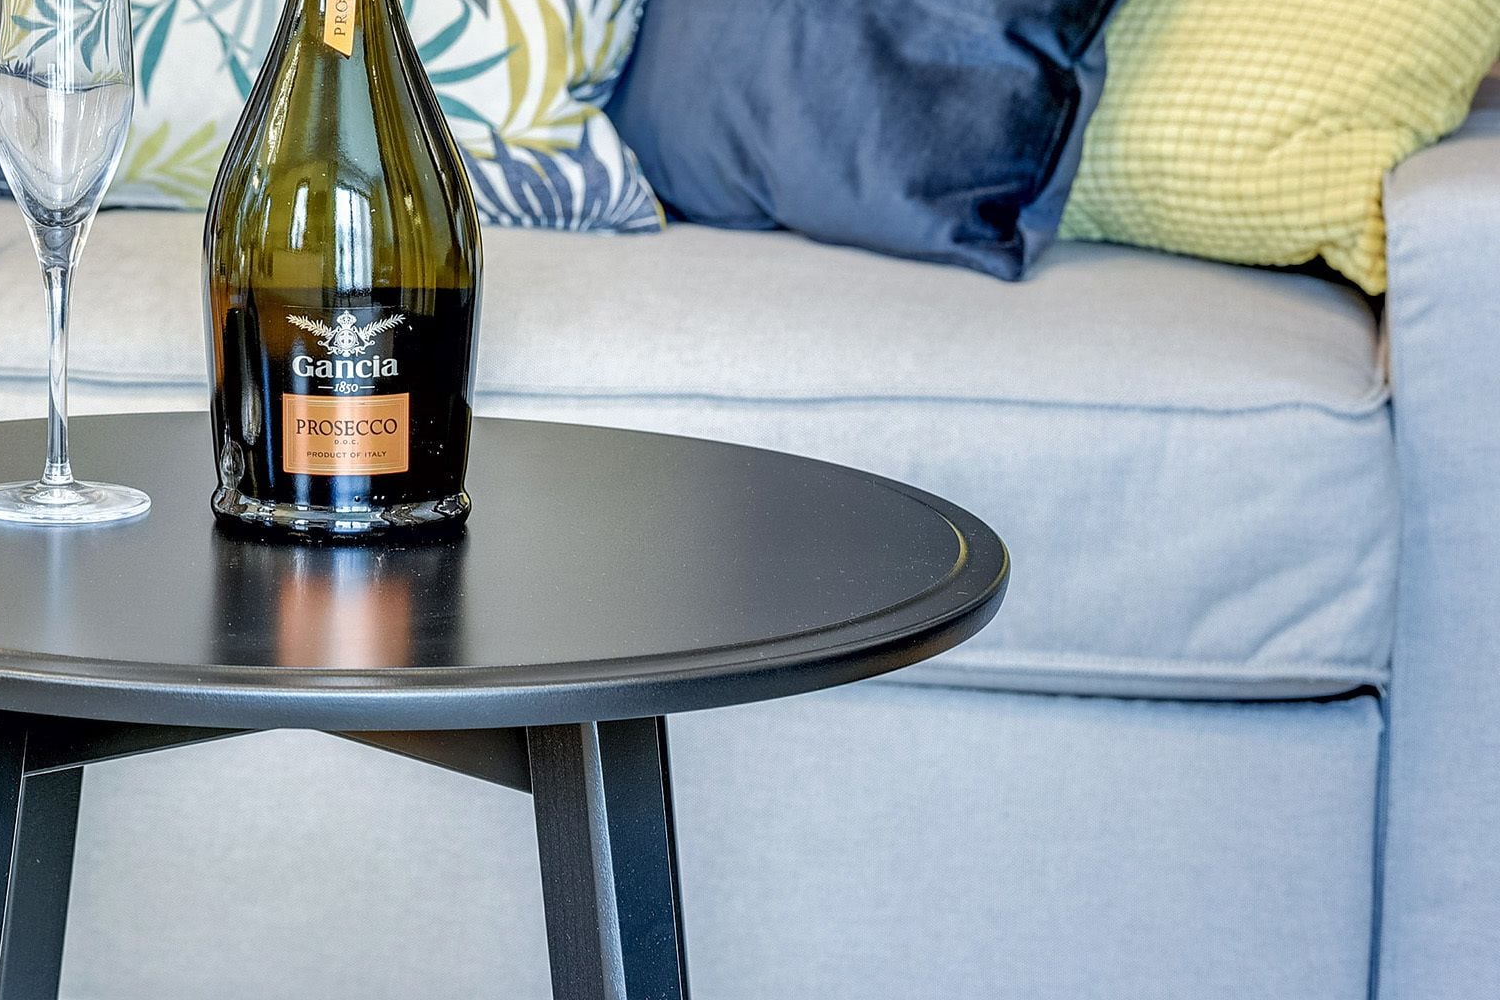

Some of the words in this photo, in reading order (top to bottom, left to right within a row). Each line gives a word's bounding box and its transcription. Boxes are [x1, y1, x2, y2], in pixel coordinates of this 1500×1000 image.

[291, 354, 400, 379] Gancia
[333, 380, 359, 395] 1850
[295, 417, 398, 437] PROSECCO
[306, 451, 347, 459] PRODUCT
[349, 451, 361, 459] OF
[364, 450, 388, 458] ITALY
